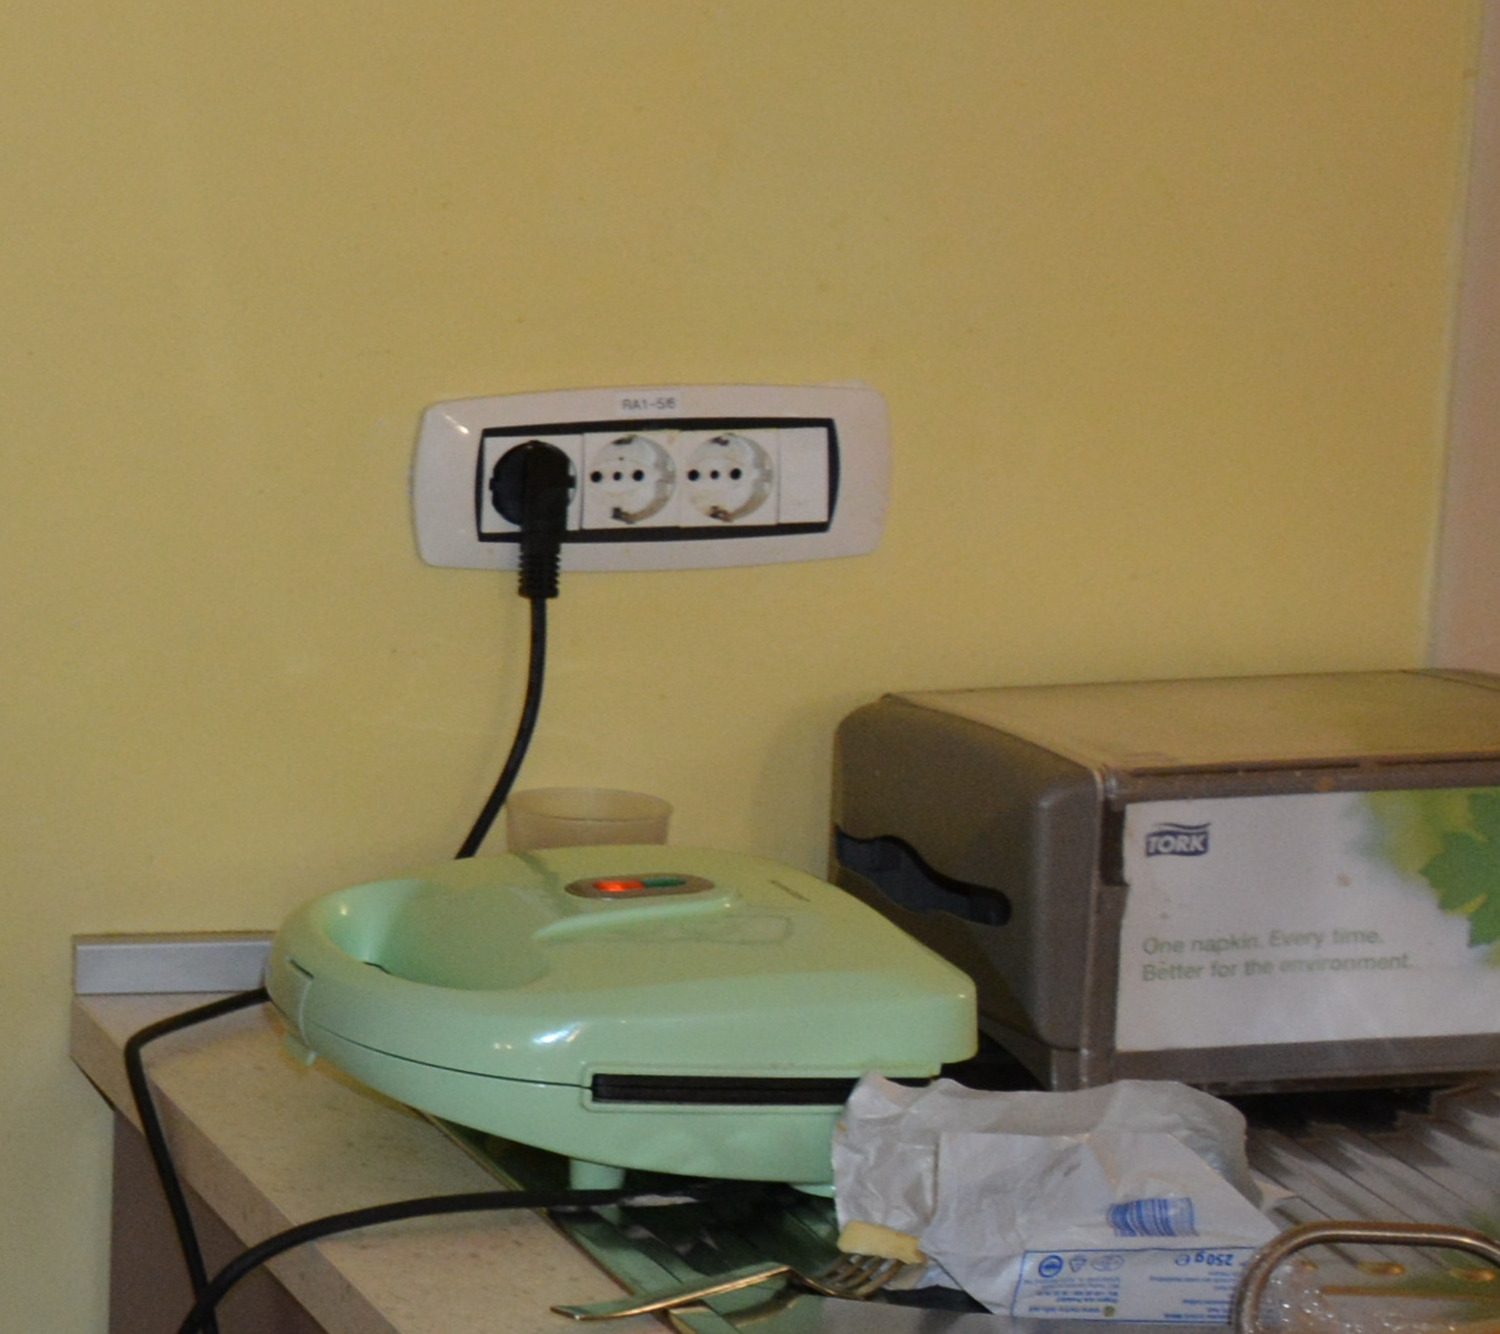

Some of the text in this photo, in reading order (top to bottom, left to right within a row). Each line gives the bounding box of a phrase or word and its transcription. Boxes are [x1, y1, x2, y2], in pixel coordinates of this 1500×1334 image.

[1148, 834, 1207, 854] TORK
[1142, 927, 1384, 955] One napkin. Every time.
[1142, 952, 1414, 982] Better for the environment.
[1207, 1253, 1235, 1267] 250
